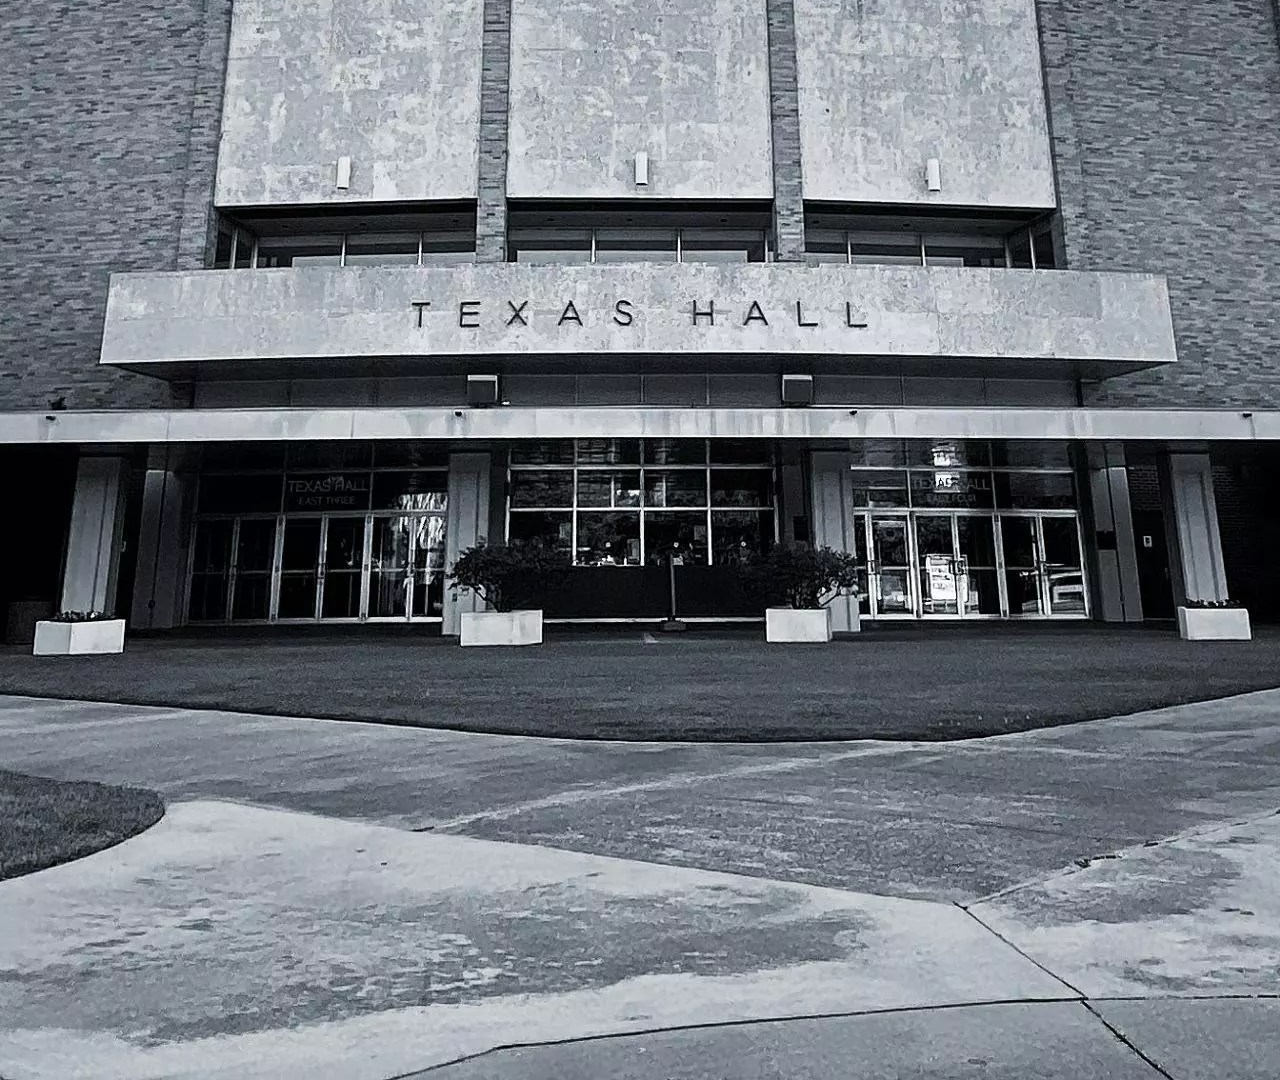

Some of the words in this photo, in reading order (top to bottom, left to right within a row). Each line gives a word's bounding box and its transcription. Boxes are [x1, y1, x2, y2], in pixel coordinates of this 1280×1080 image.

[411, 299, 633, 328] TEXAS
[692, 300, 868, 328] HALL
[288, 479, 331, 493] TEXAS
[334, 479, 369, 492] HALL
